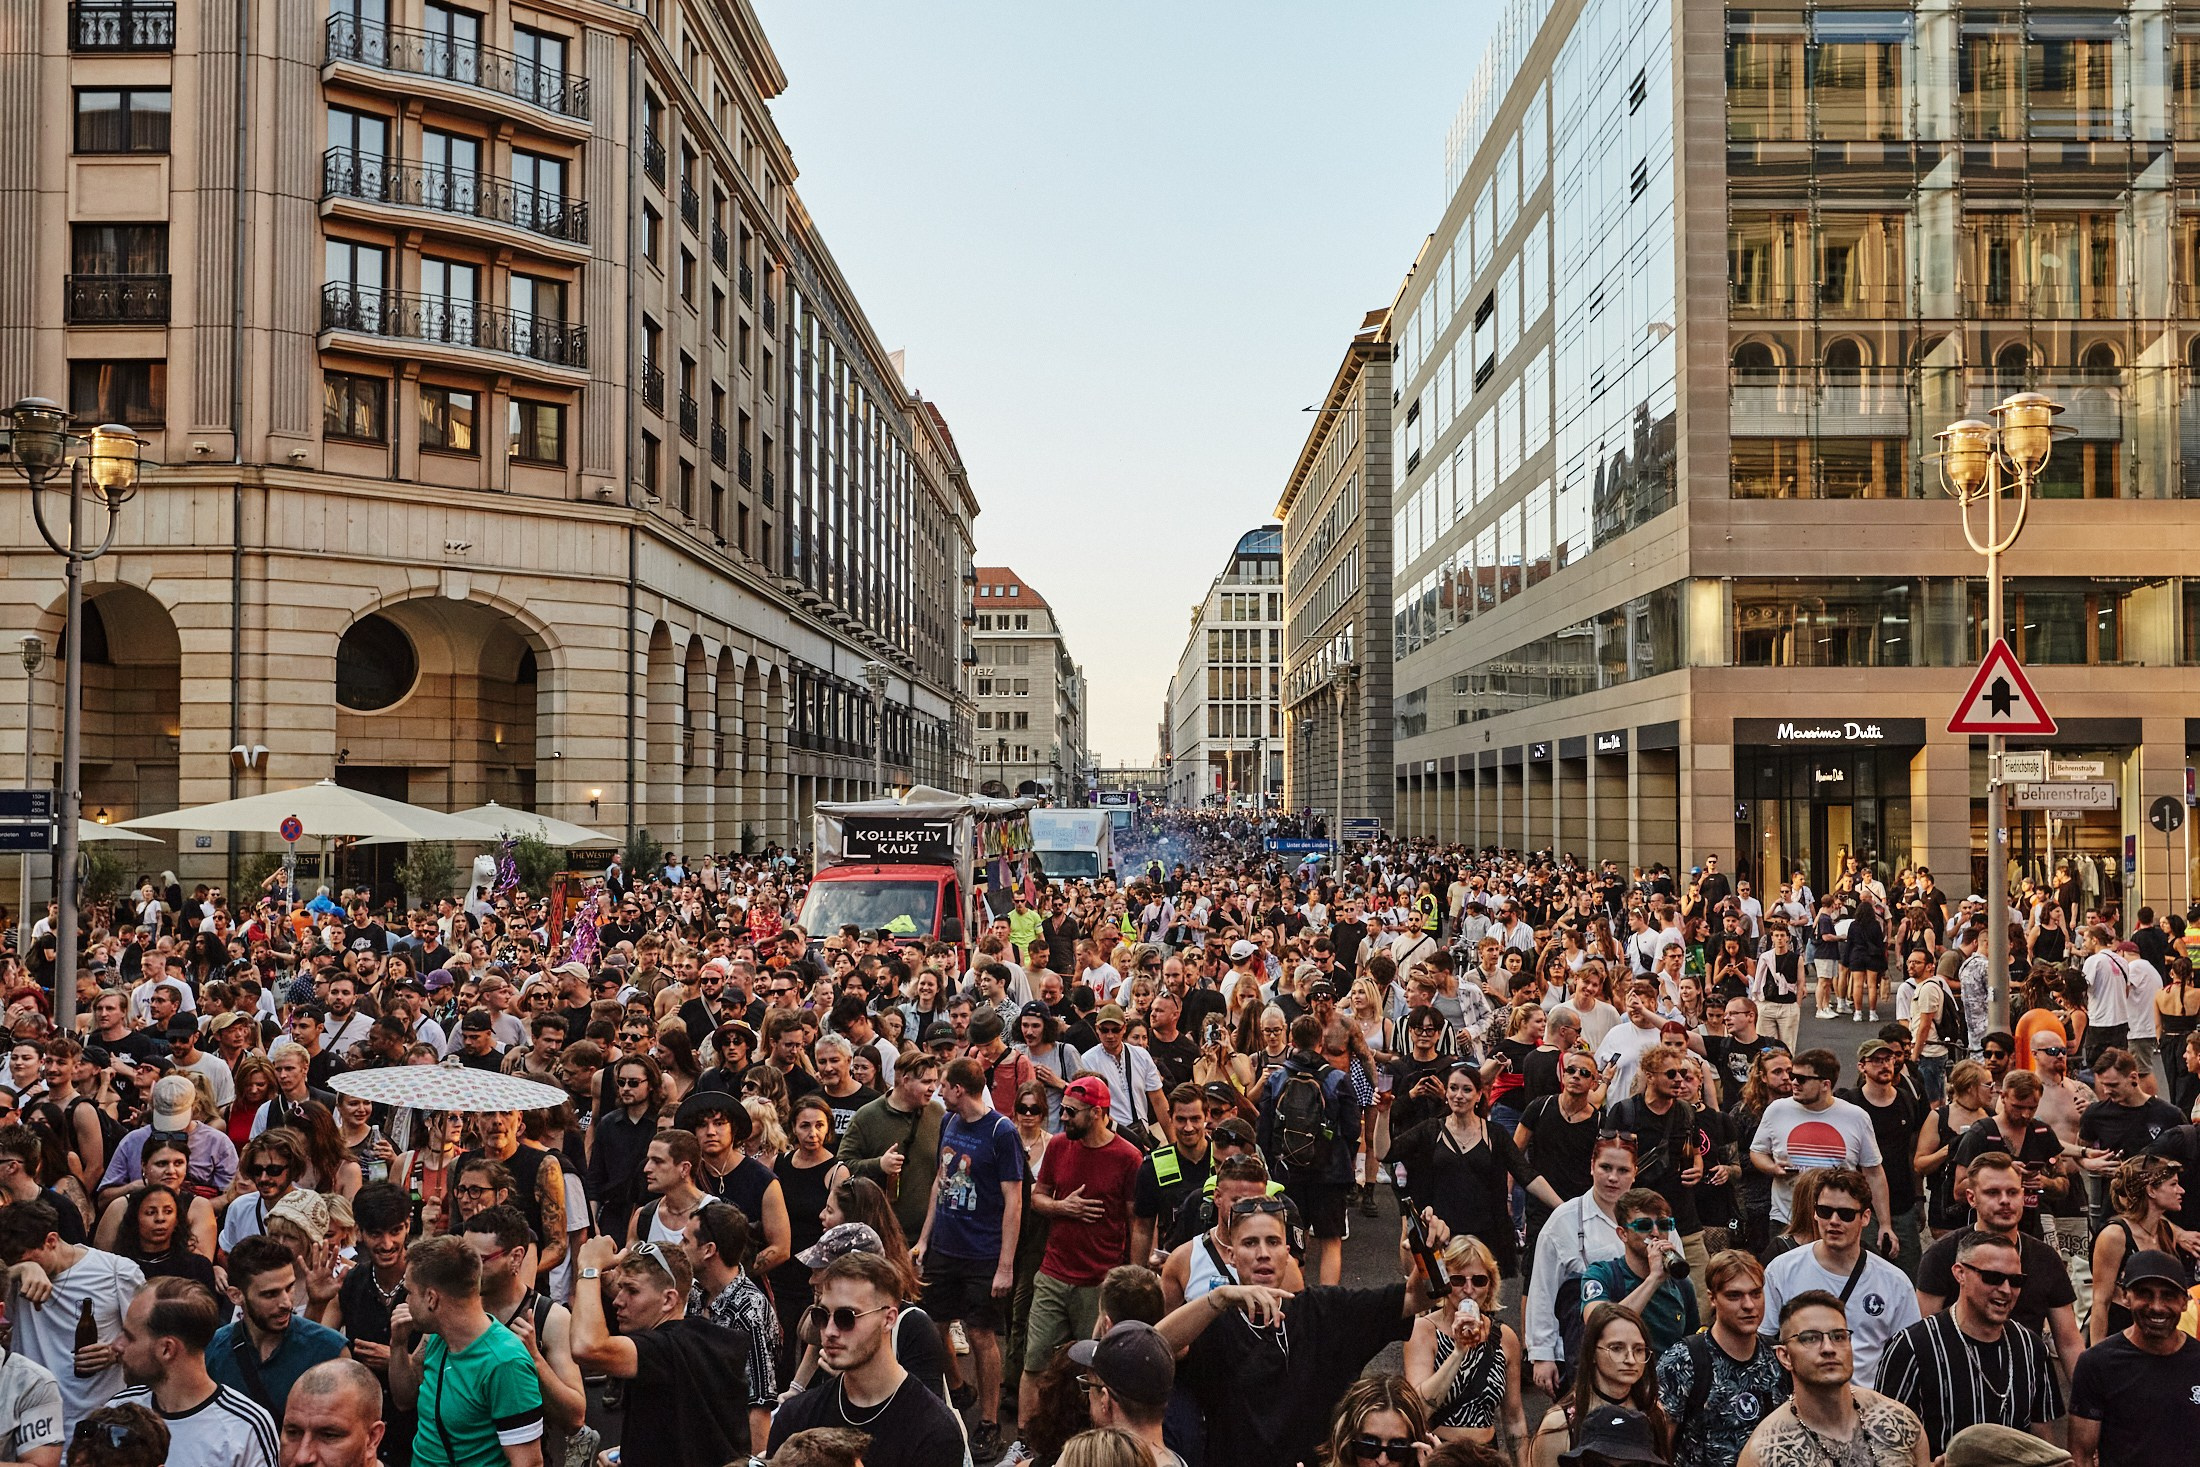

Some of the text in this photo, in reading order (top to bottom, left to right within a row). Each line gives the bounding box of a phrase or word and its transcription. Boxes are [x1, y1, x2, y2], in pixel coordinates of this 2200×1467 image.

[1777, 722, 1883, 740] Massimo Dutti
[2005, 759, 2039, 776] Friedrichstraße
[2057, 764, 2097, 773] Behrenstraße
[2021, 787, 2107, 804] Behrenstraße
[855, 830, 941, 842] KOLLEKTIV
[877, 843, 919, 855] KAUZ
[1269, 841, 1277, 850] U
[1286, 841, 1300, 849] Unter
